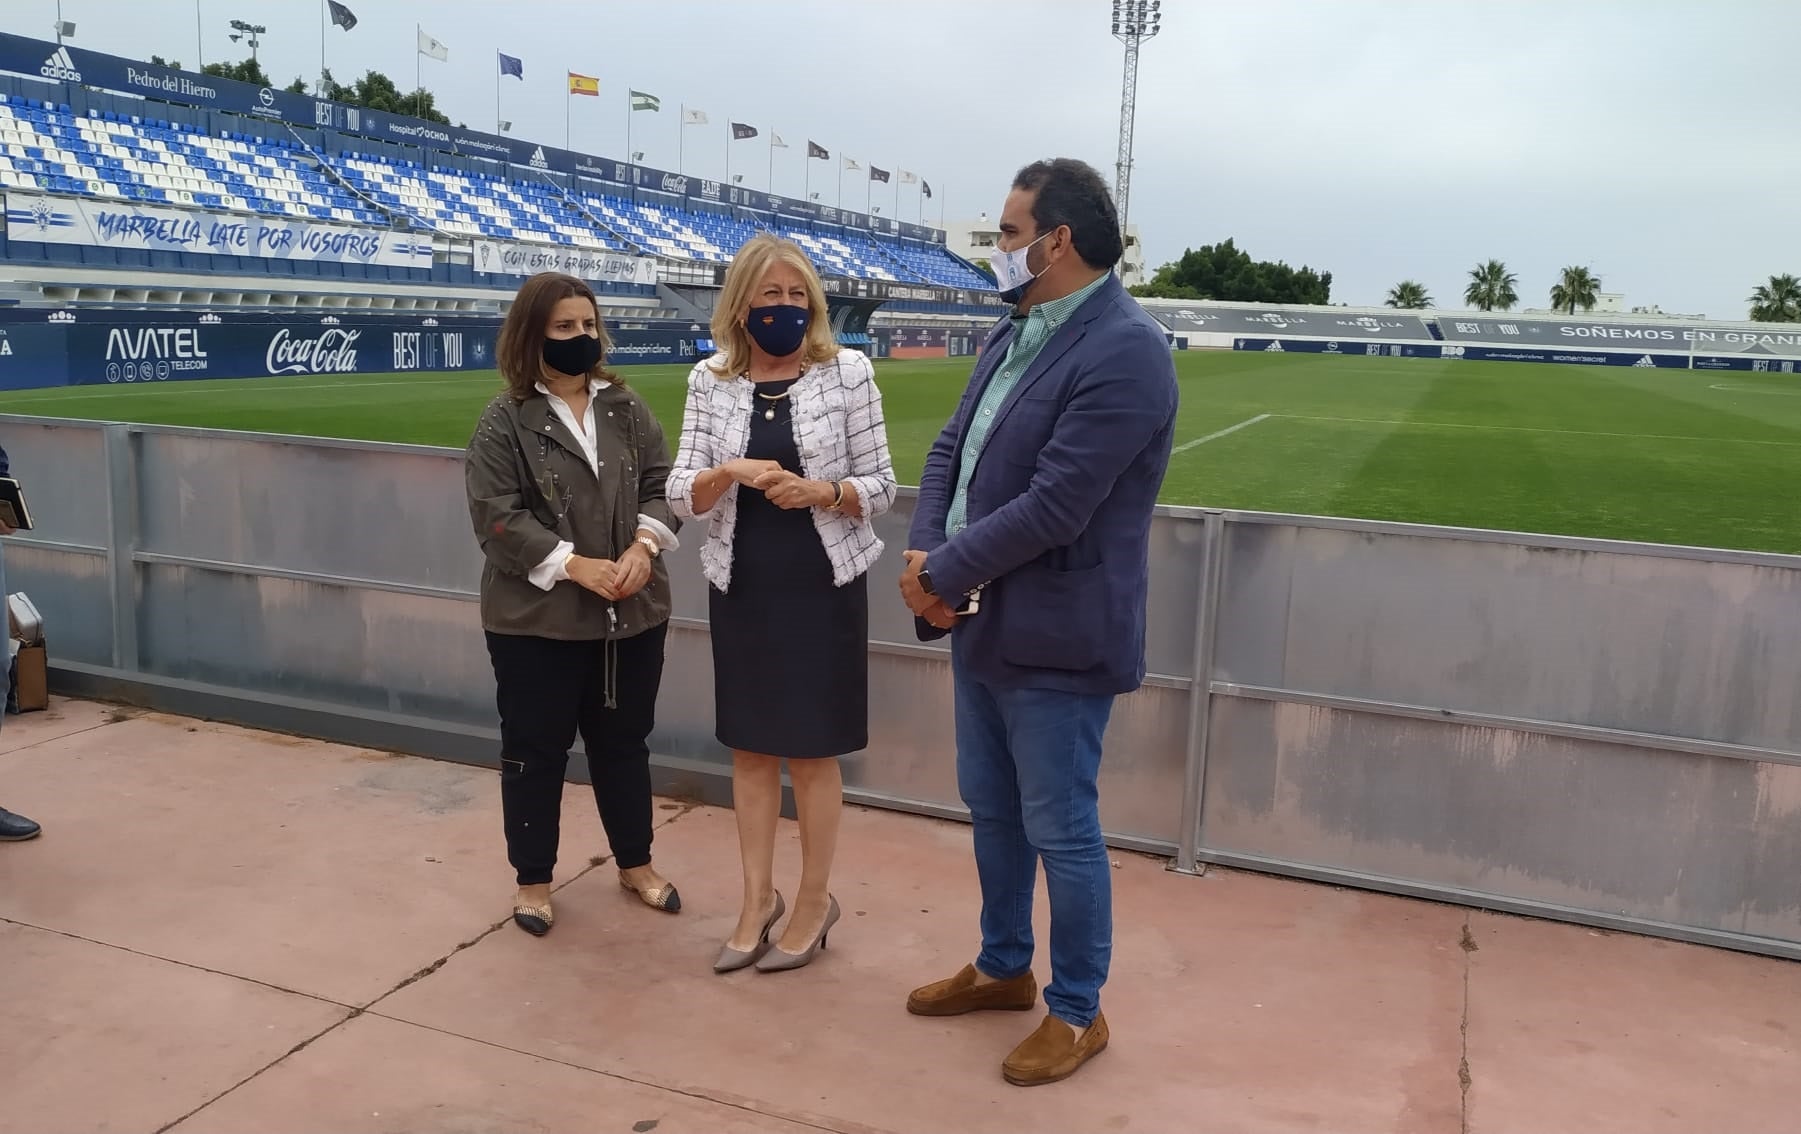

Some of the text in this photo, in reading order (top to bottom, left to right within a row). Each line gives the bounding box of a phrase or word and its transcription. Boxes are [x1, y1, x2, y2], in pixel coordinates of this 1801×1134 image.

[41, 65, 82, 82] adidas
[127, 67, 216, 99] Pedro del Hierro
[315, 101, 333, 126] BEST
[346, 108, 360, 131] YOU
[389, 123, 449, 142] Hospital OCHOA
[97, 211, 380, 257] MARBELLA LATE POR VOSOTROS
[504, 251, 527, 265] CON
[530, 254, 560, 270] ESTAS
[564, 257, 601, 273] GRADAS
[1244, 316, 1307, 324] MARBELLA
[1336, 320, 1404, 328] MARBELLA
[1455, 322, 1481, 334] BEST
[1497, 323, 1520, 335] YOU
[1560, 326, 1675, 340] SOÑEMOS
[1683, 331, 1716, 342] EN
[105, 328, 207, 360] AVATEL
[266, 328, 362, 374] Coca-Cola
[393, 332, 463, 369] BEST OF YOU
[679, 339, 696, 356] Pedr
[171, 360, 208, 370] TELECOM
